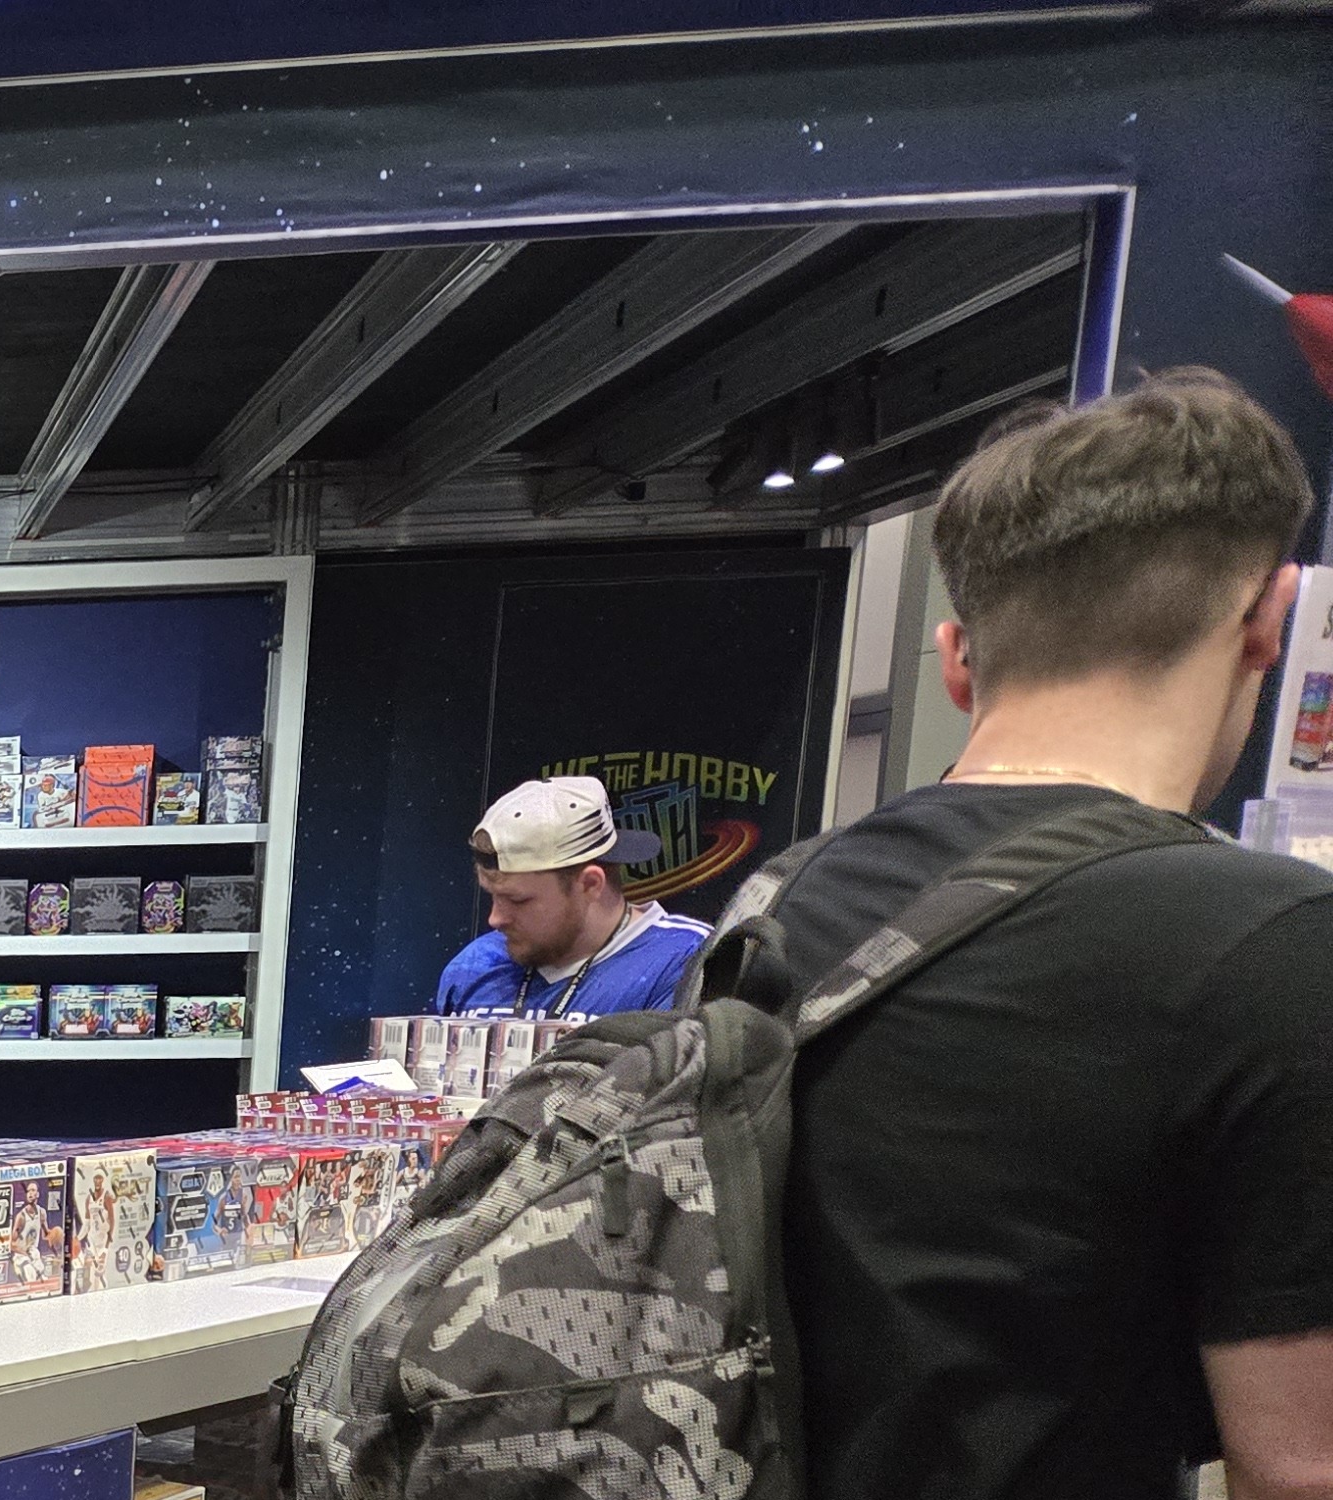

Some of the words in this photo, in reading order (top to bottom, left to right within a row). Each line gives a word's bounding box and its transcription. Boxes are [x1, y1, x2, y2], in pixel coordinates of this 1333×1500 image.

[605, 758, 640, 792] THE
[644, 751, 779, 805] HOBBY
[0, 1168, 26, 1181] MEGA
[27, 1165, 46, 1178] BOX
